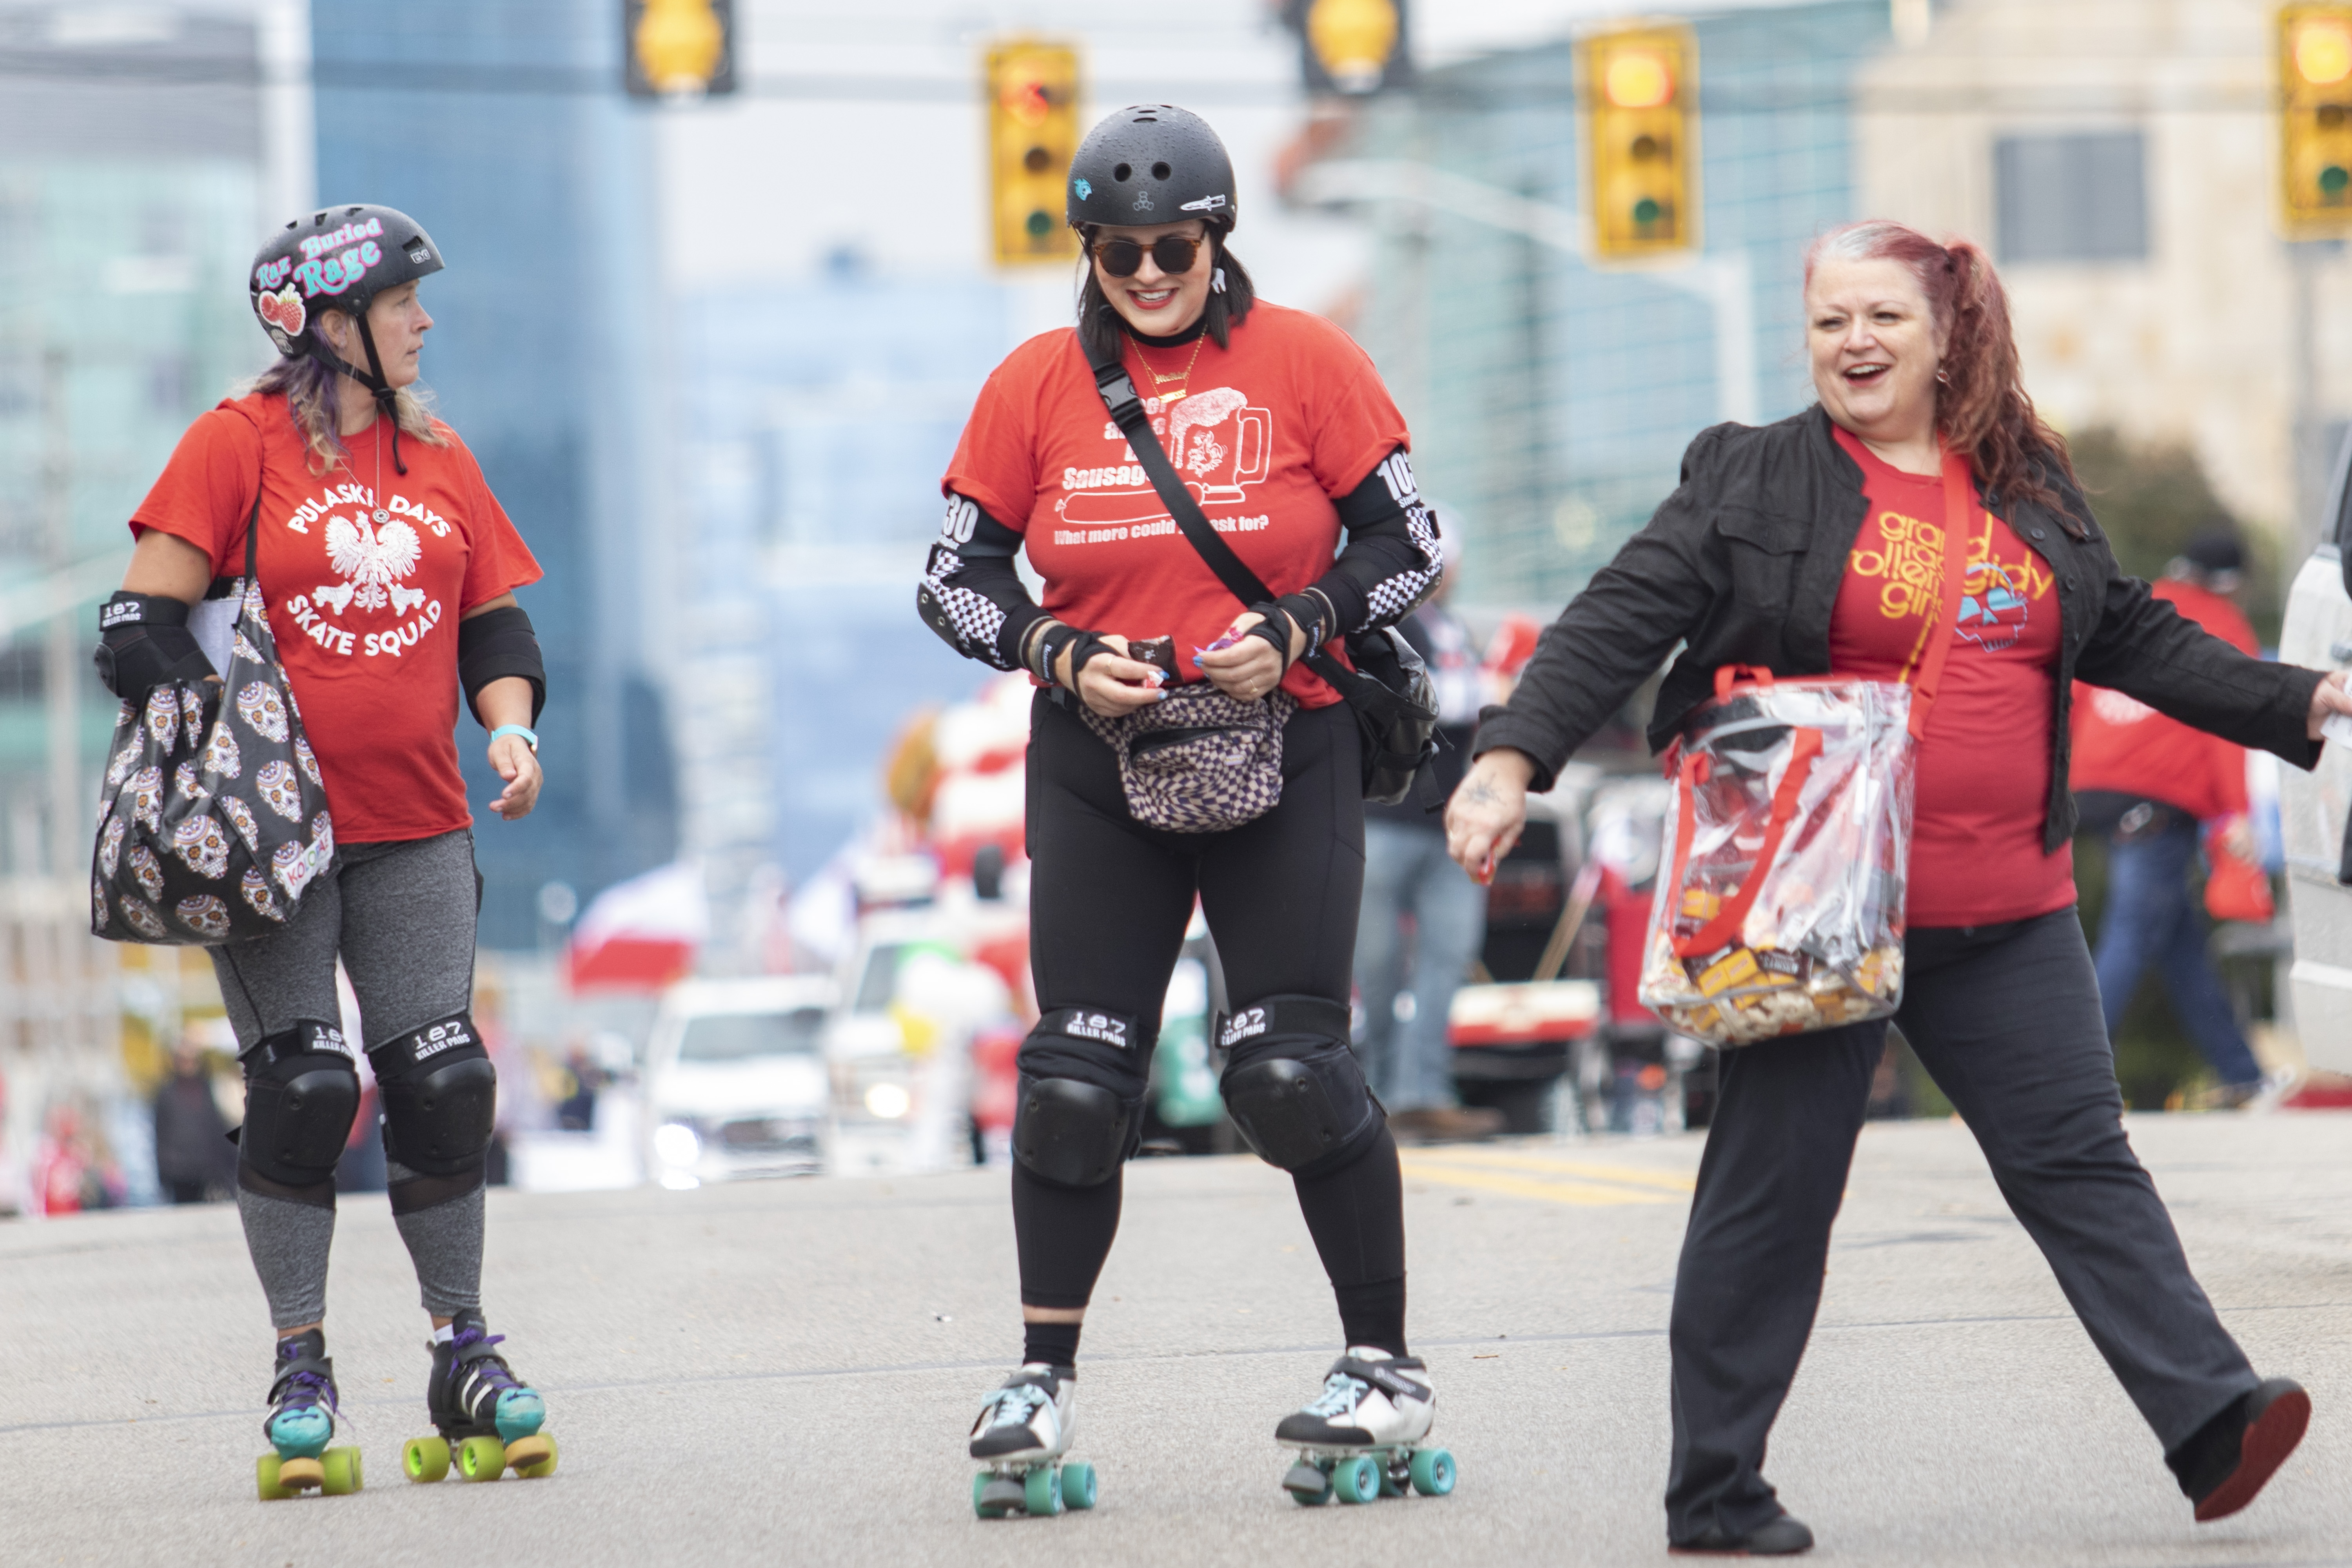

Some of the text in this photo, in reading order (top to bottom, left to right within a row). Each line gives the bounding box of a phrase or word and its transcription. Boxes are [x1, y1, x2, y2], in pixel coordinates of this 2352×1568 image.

[300, 218, 383, 260] Buried
[256, 256, 292, 290] Raz
[293, 241, 382, 298] Rage
[1062, 465, 1151, 490] Sausag
[287, 483, 451, 537] PULASKI DAYS
[1054, 530, 1087, 545] What
[1088, 527, 1128, 543] more
[1131, 519, 1176, 539] could
[1239, 514, 1269, 532] for?
[104, 601, 140, 618] 187
[287, 594, 441, 657] SKATE SQUAD
[315, 1026, 344, 1043] 18
[415, 1021, 461, 1049] 187
[1067, 1022, 1126, 1047] KILLER PADS
[1072, 1011, 1126, 1034] 187
[1242, 1022, 1266, 1038] PADS
[312, 1039, 341, 1052] KILLER
[415, 1033, 471, 1061] KILLER PADS
